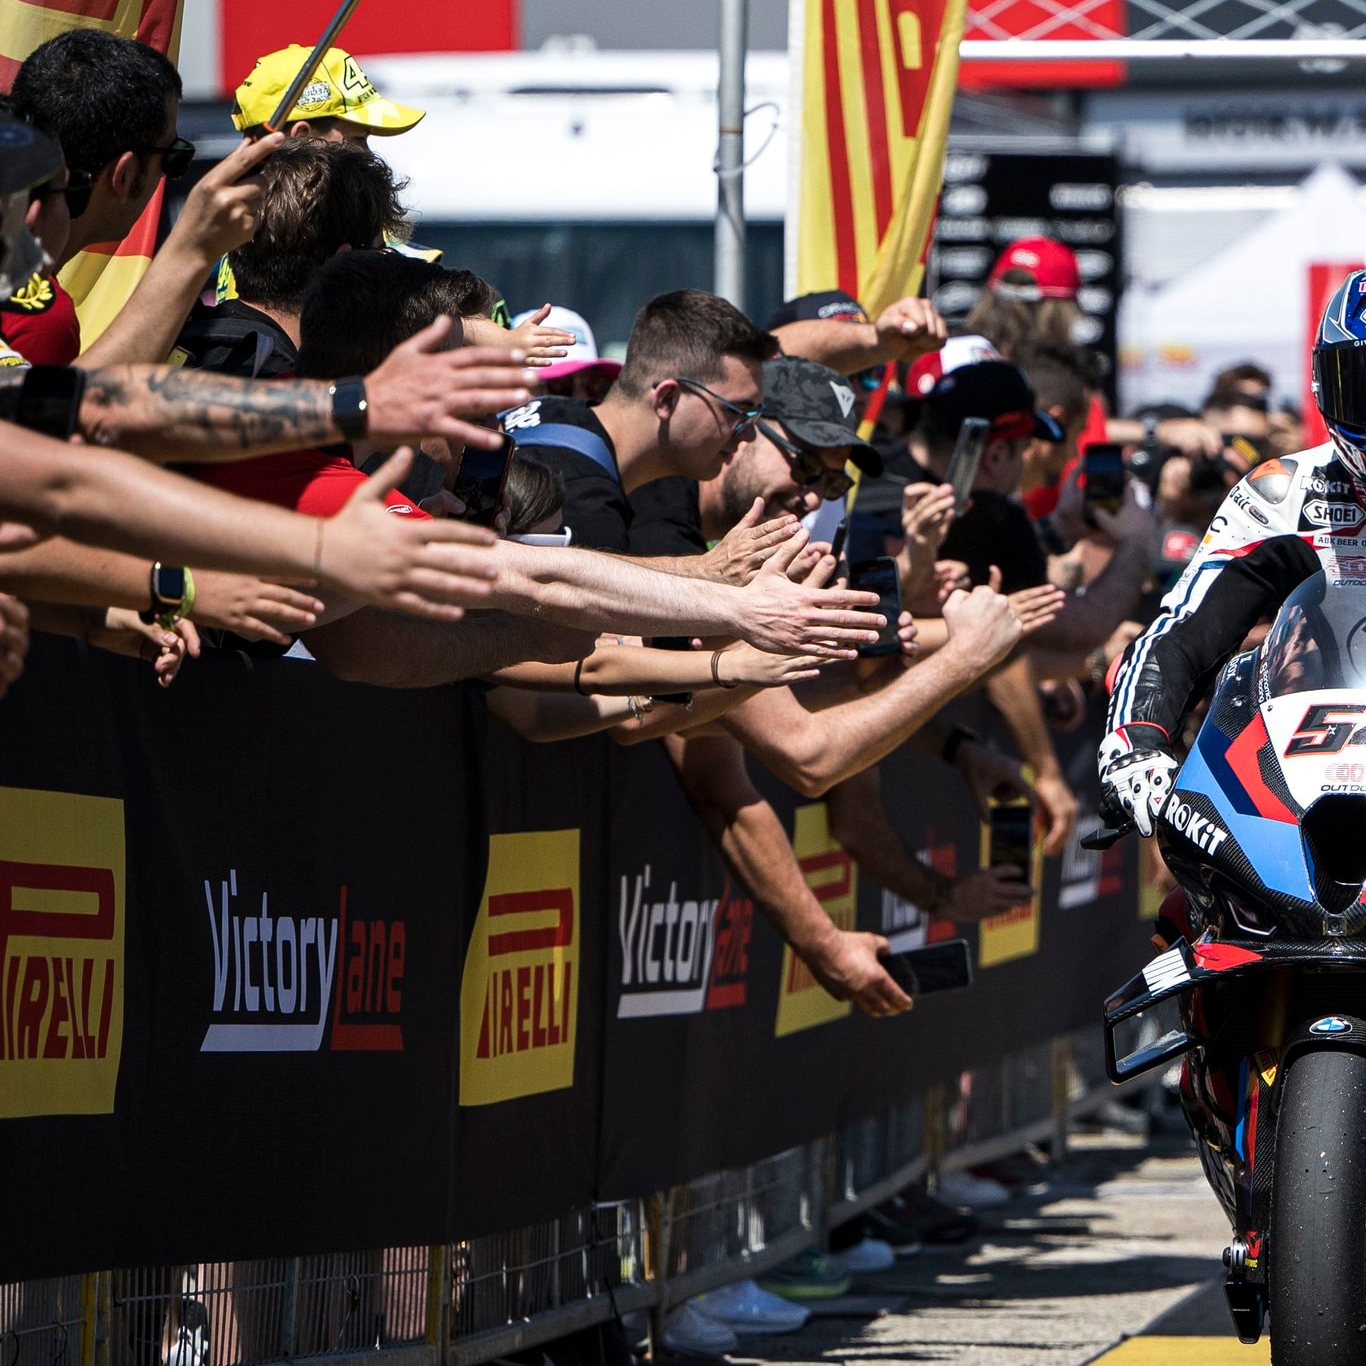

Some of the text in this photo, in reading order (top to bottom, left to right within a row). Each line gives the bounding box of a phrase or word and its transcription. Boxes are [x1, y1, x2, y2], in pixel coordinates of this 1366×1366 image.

[1313, 505, 1357, 523] SHOEI
[1336, 537, 1358, 547] BEER
[1164, 792, 1229, 857] ROKiT
[476, 887, 575, 1061] PIRELLI
